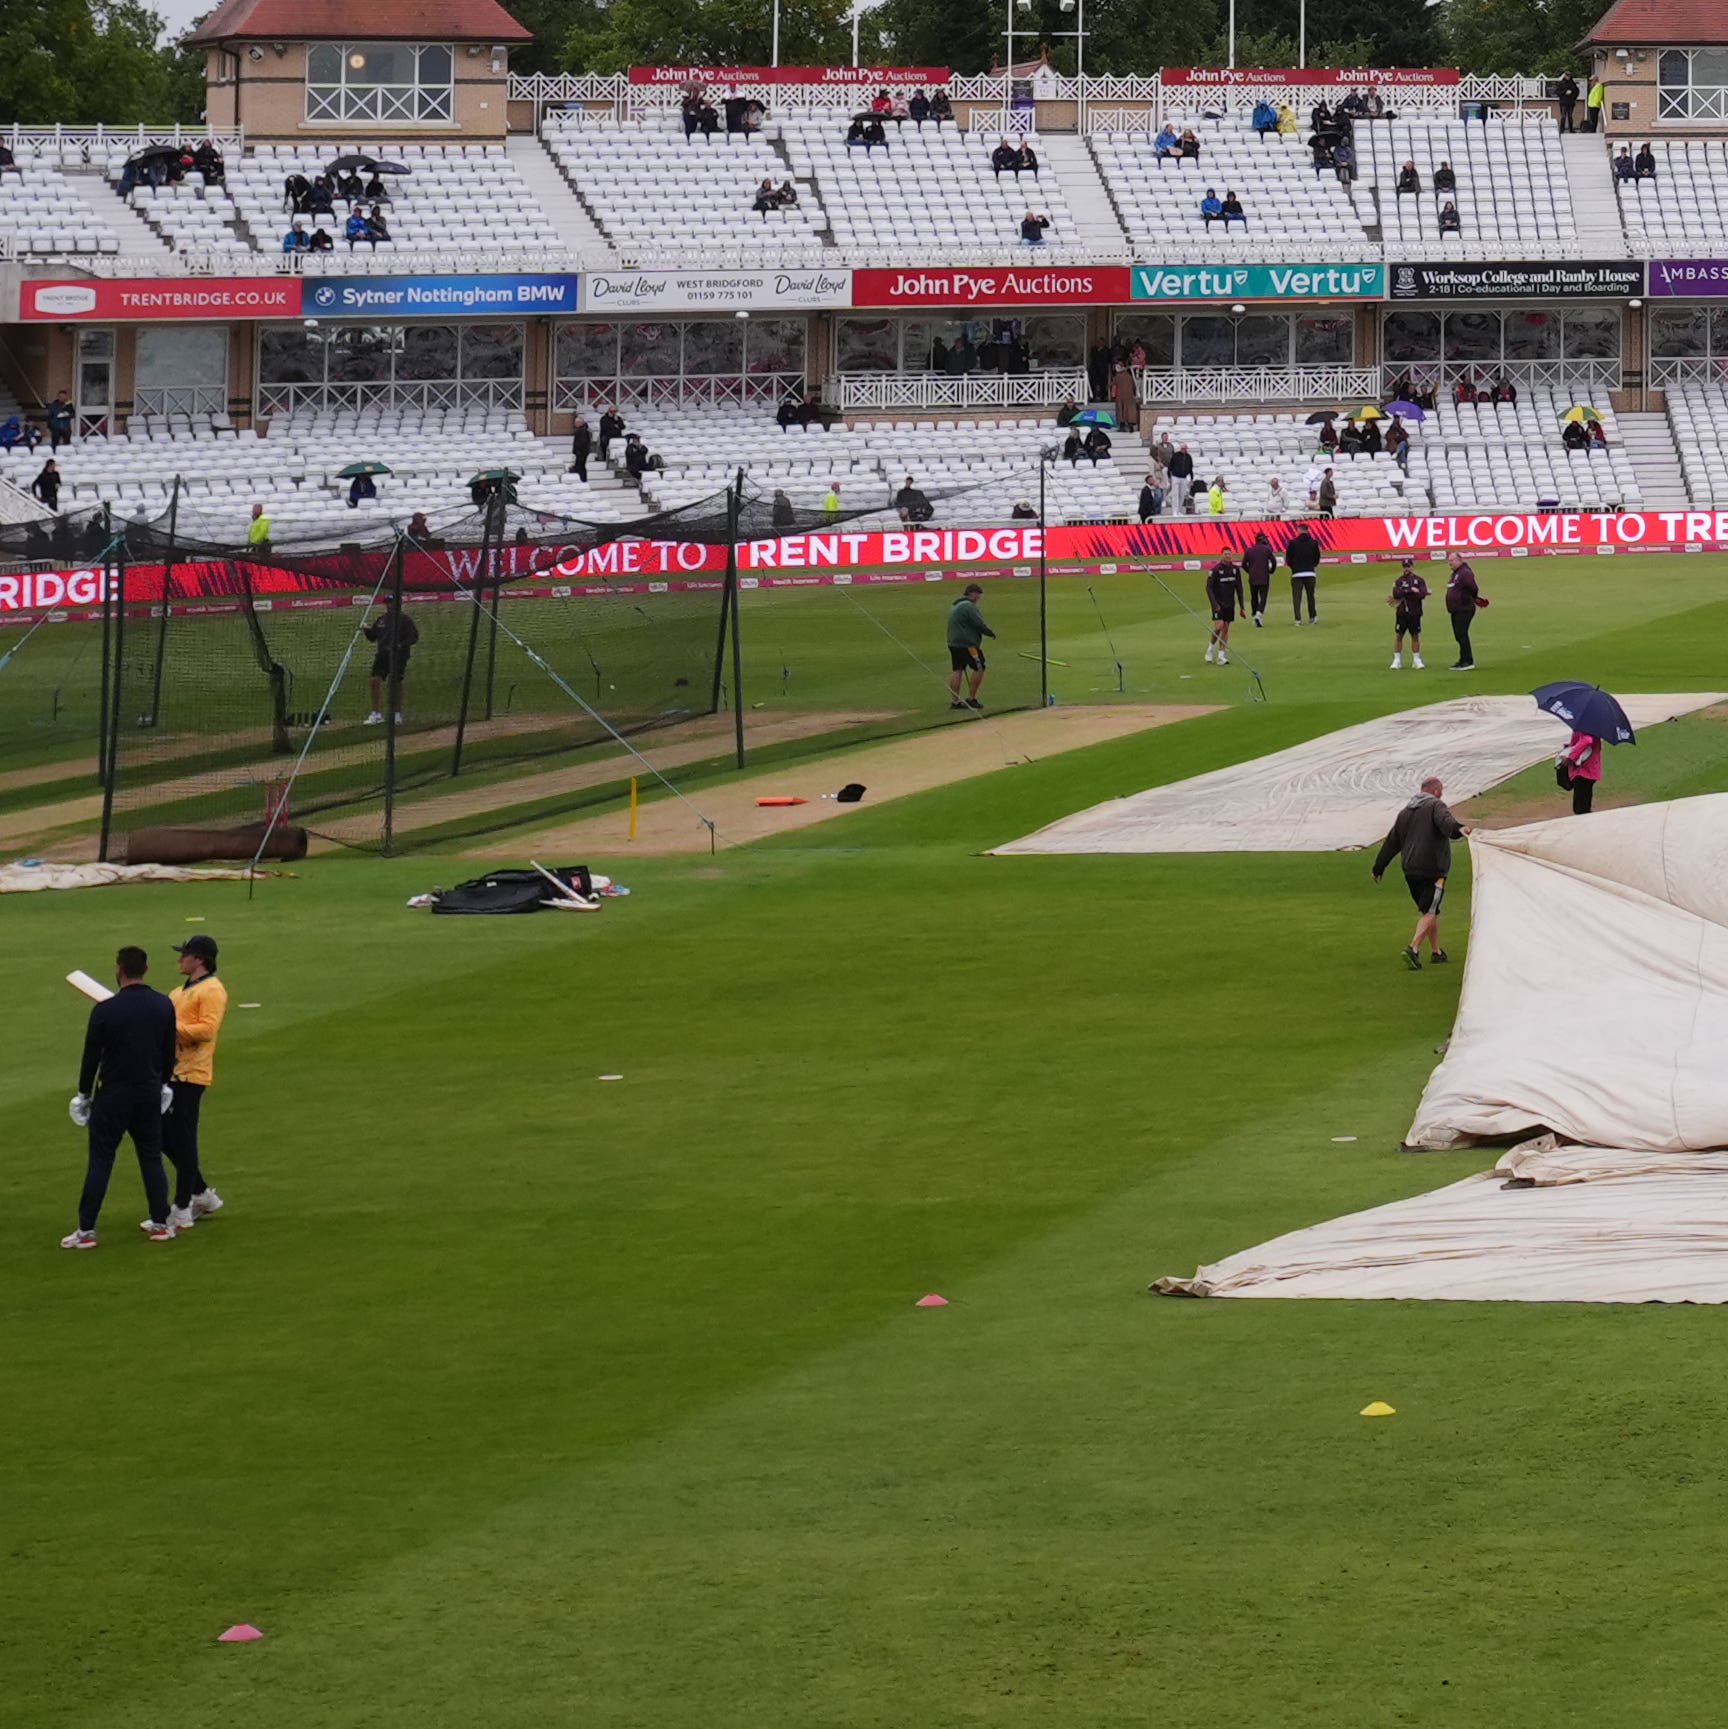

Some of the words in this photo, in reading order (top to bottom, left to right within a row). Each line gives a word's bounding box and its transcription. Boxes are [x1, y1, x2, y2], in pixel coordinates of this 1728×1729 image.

[652, 68, 687, 81] John
[688, 68, 714, 83] Pye
[716, 71, 759, 81] Auctions
[822, 68, 856, 81] John
[858, 68, 884, 83] Pye
[885, 71, 927, 81] Auctions
[1186, 69, 1219, 82] John
[1220, 69, 1244, 84] Pye
[1246, 72, 1286, 82] Auctions
[1336, 69, 1368, 82] John
[1370, 69, 1393, 84] Pye
[1395, 72, 1434, 82] Auctions
[677, 280, 705, 289] WEST
[706, 279, 763, 289] BRIDGFORD
[774, 274, 813, 295] David
[814, 273, 847, 294] Lloyd
[1139, 271, 1233, 296] Vertu
[1269, 269, 1360, 294] Vertu
[1422, 270, 1481, 286] Worksop
[1482, 270, 1529, 286] College
[1529, 270, 1553, 282] and
[1555, 269, 1599, 285] Ranby
[1599, 270, 1640, 283] House
[592, 277, 633, 298] David
[634, 276, 667, 297] Lloyd
[687, 291, 717, 300] 01159
[718, 291, 735, 299] 775
[736, 290, 753, 299] 101
[890, 275, 949, 296] John
[953, 275, 996, 299] Pye
[1000, 274, 1093, 294] Auctions
[1458, 283, 1535, 293] Co-educational
[1542, 283, 1560, 293] Day
[1563, 284, 1582, 292] and
[1584, 283, 1630, 294] Boarding
[120, 291, 287, 306] TRENTBRIDGE.CO.UK
[343, 287, 403, 307] Sytner
[407, 285, 513, 306] Nottingham
[517, 285, 565, 301] BMW
[1384, 514, 1581, 548] WELCOME
[1591, 512, 1646, 543] TO
[651, 541, 707, 571] TO
[734, 534, 867, 568] TRENT
[882, 528, 1046, 563] BRIDGE
